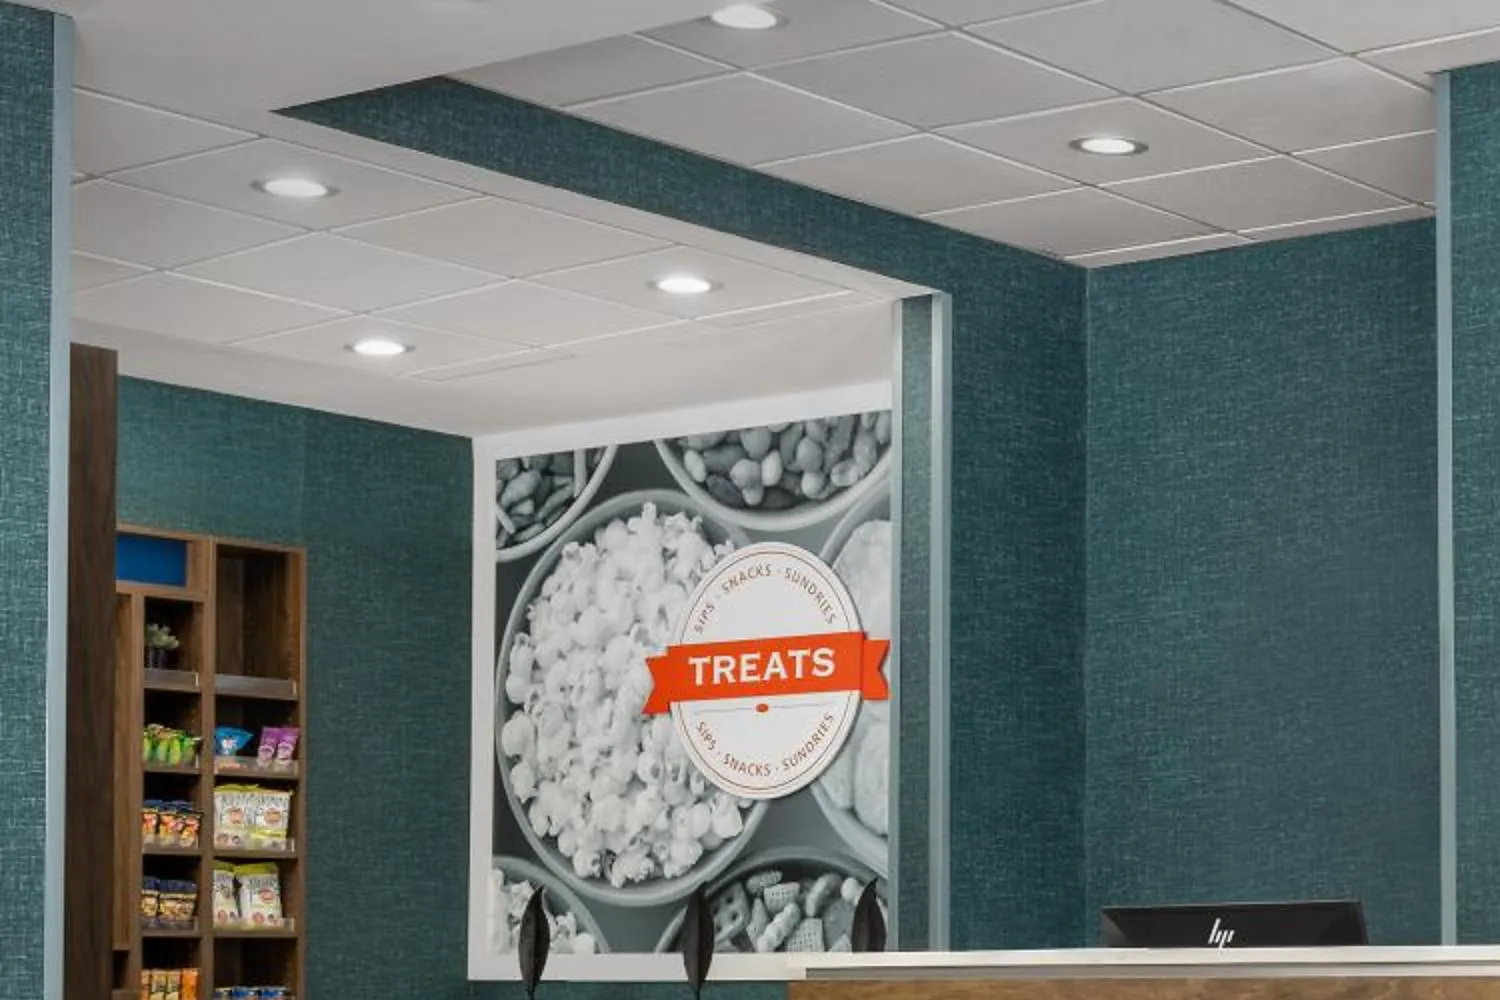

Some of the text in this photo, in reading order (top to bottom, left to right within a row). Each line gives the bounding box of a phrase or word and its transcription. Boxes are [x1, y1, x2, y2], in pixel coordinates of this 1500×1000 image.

[693, 563, 838, 634] SIPS SNACKS SUNDRIES
[688, 647, 837, 687] TREATS
[697, 713, 835, 777] SIPS SNACKS SUNDRIES
